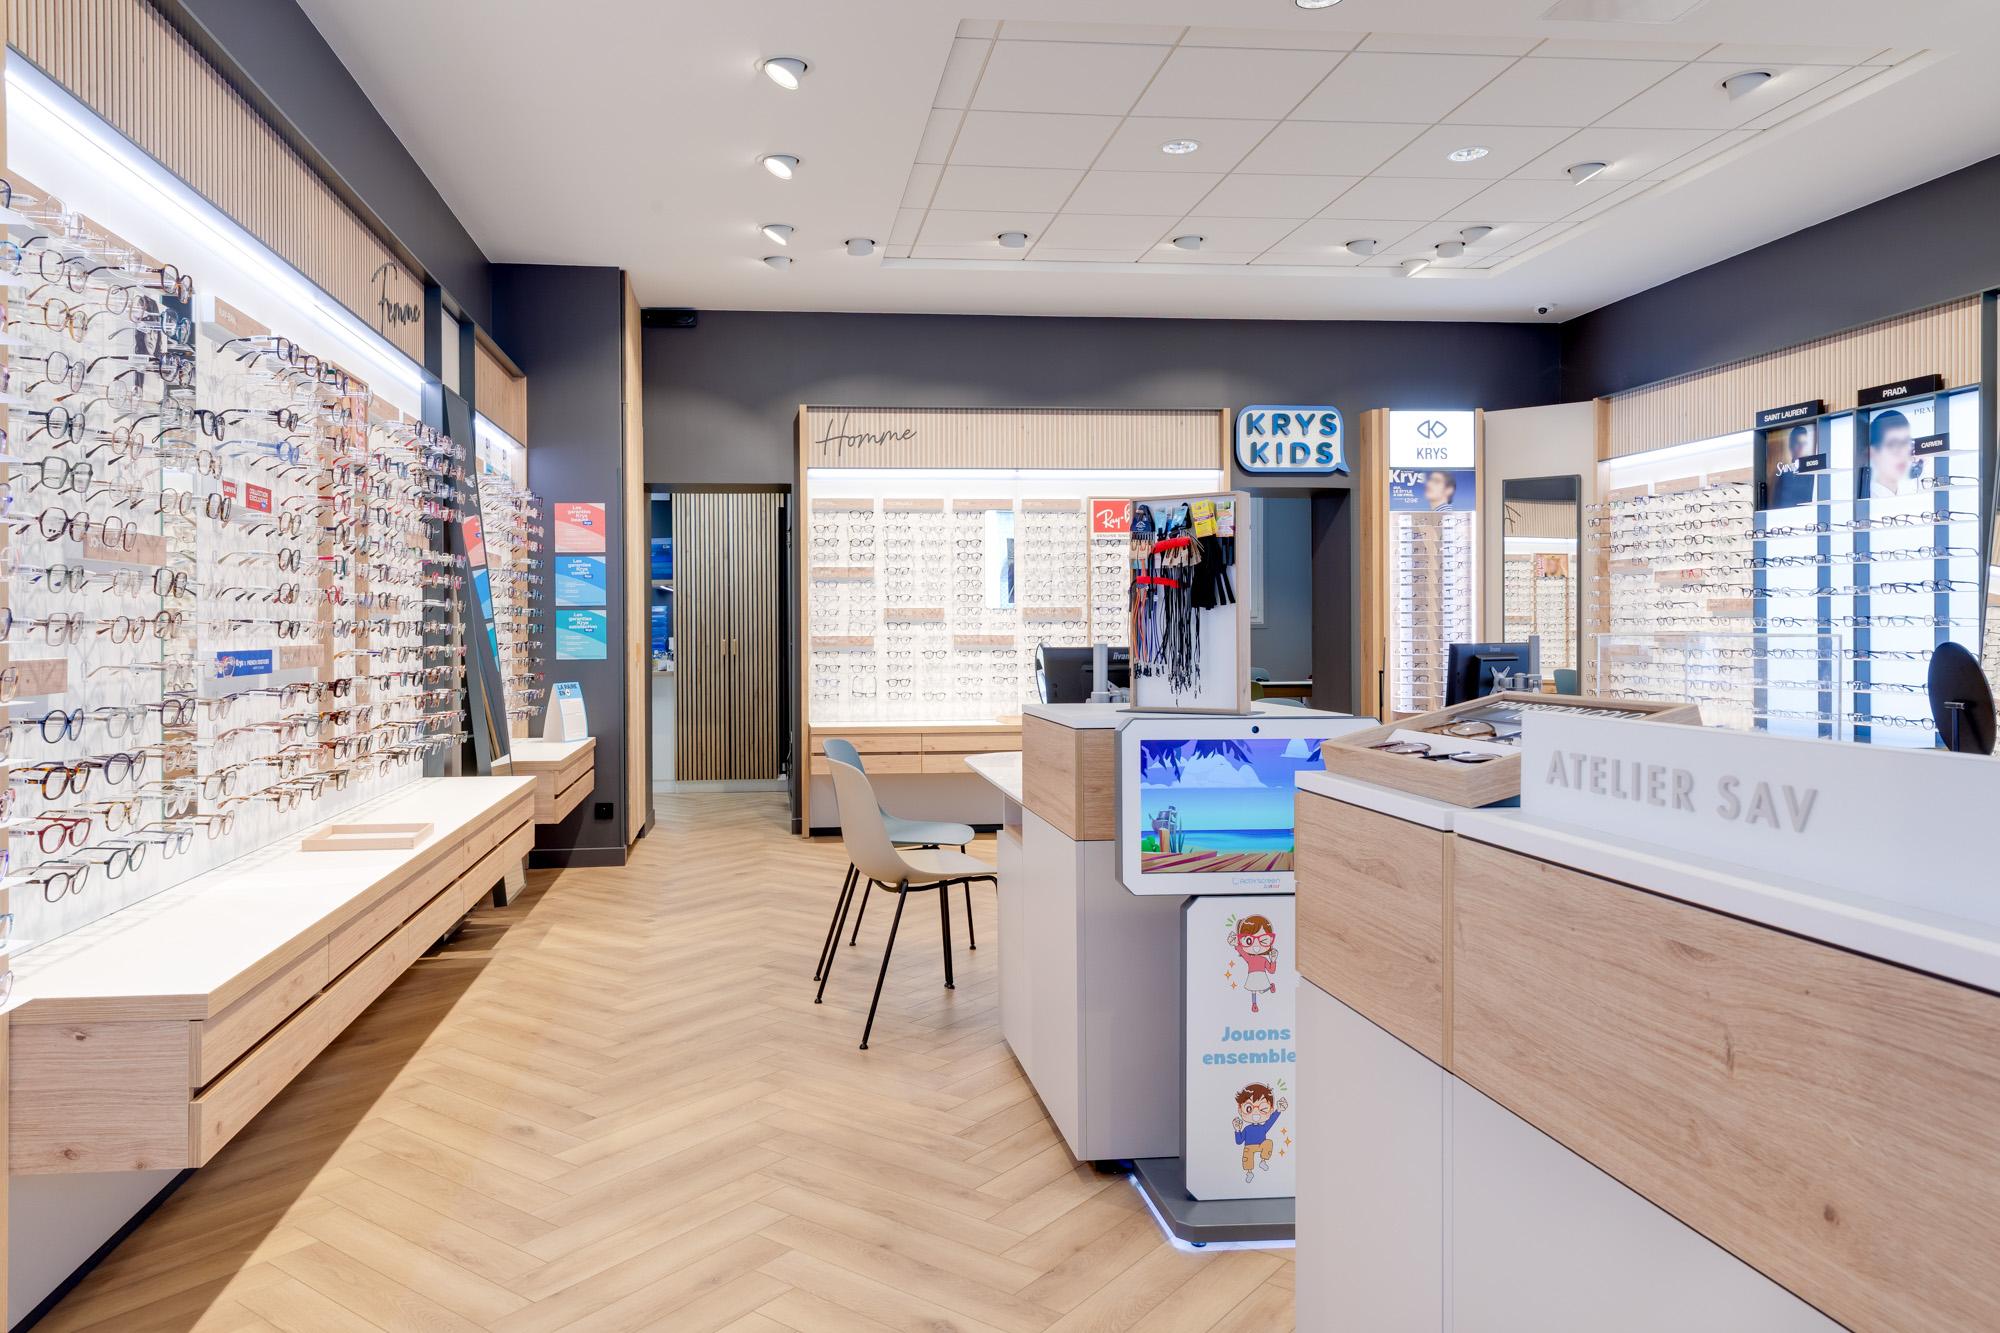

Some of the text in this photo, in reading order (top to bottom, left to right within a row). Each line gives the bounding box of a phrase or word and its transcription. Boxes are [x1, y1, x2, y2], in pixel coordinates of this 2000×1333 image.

[371, 262, 421, 335] Femme
[1882, 386, 1907, 398] PRADA
[1763, 407, 1808, 422] SAINT LAURENT
[1246, 412, 1338, 437] KRYS
[815, 410, 918, 457] Homme
[1921, 439, 1943, 449] CARVEN
[1250, 441, 1334, 465] KIDS
[1416, 447, 1448, 460] KRYS
[1389, 469, 1425, 487] Krys
[1546, 750, 1818, 834] ATELIER SAV
[1221, 1026, 1291, 1042] Jouons
[1203, 1048, 1297, 1065] ensemble
